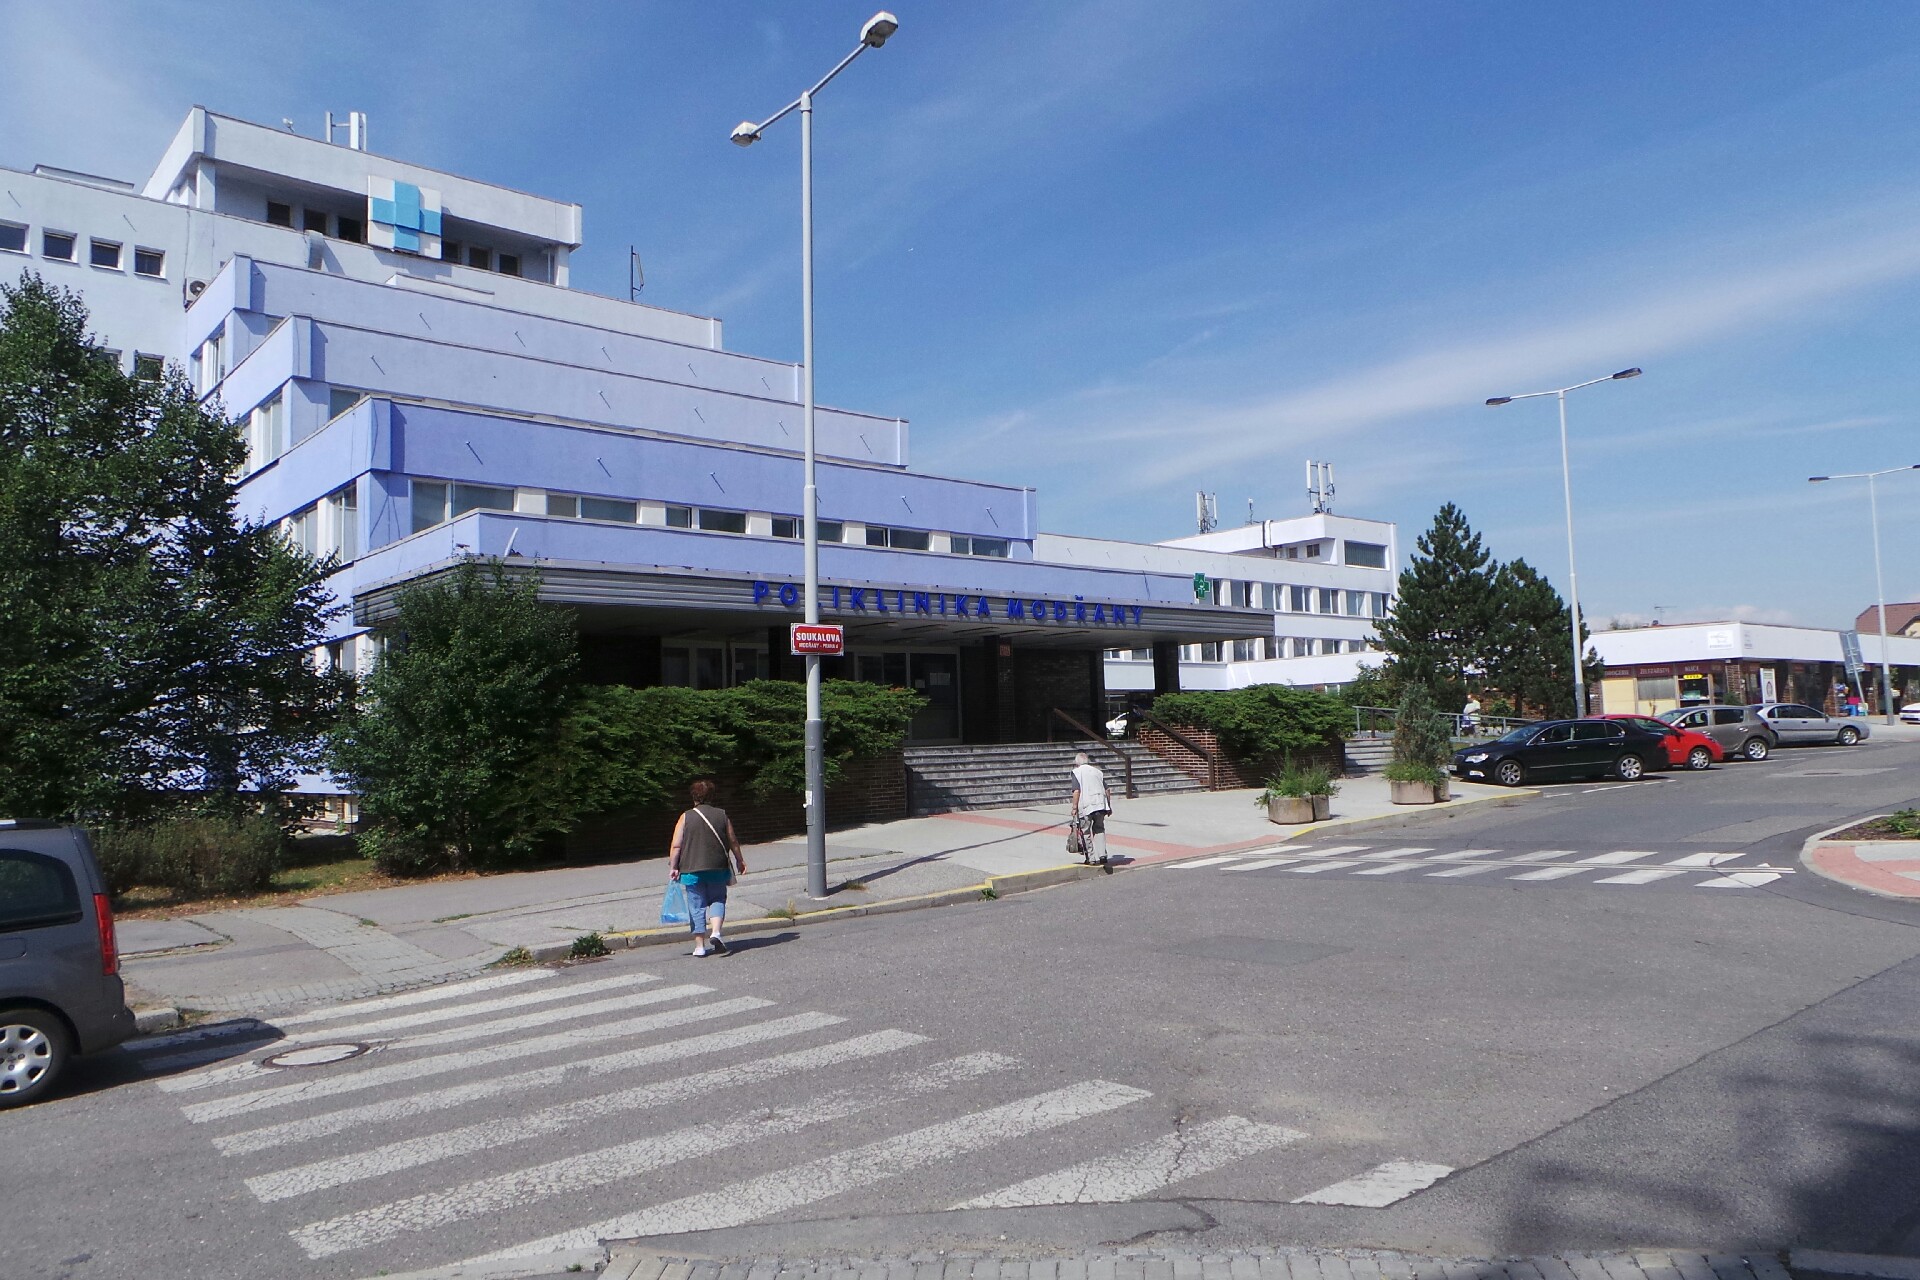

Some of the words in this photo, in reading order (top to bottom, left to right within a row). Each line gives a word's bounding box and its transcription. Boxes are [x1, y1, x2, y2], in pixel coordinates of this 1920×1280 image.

[753, 581, 991, 617] POIKLINIKA
[1007, 594, 1143, 625] MODŘANY
[796, 632, 840, 642] SOUKALOVA
